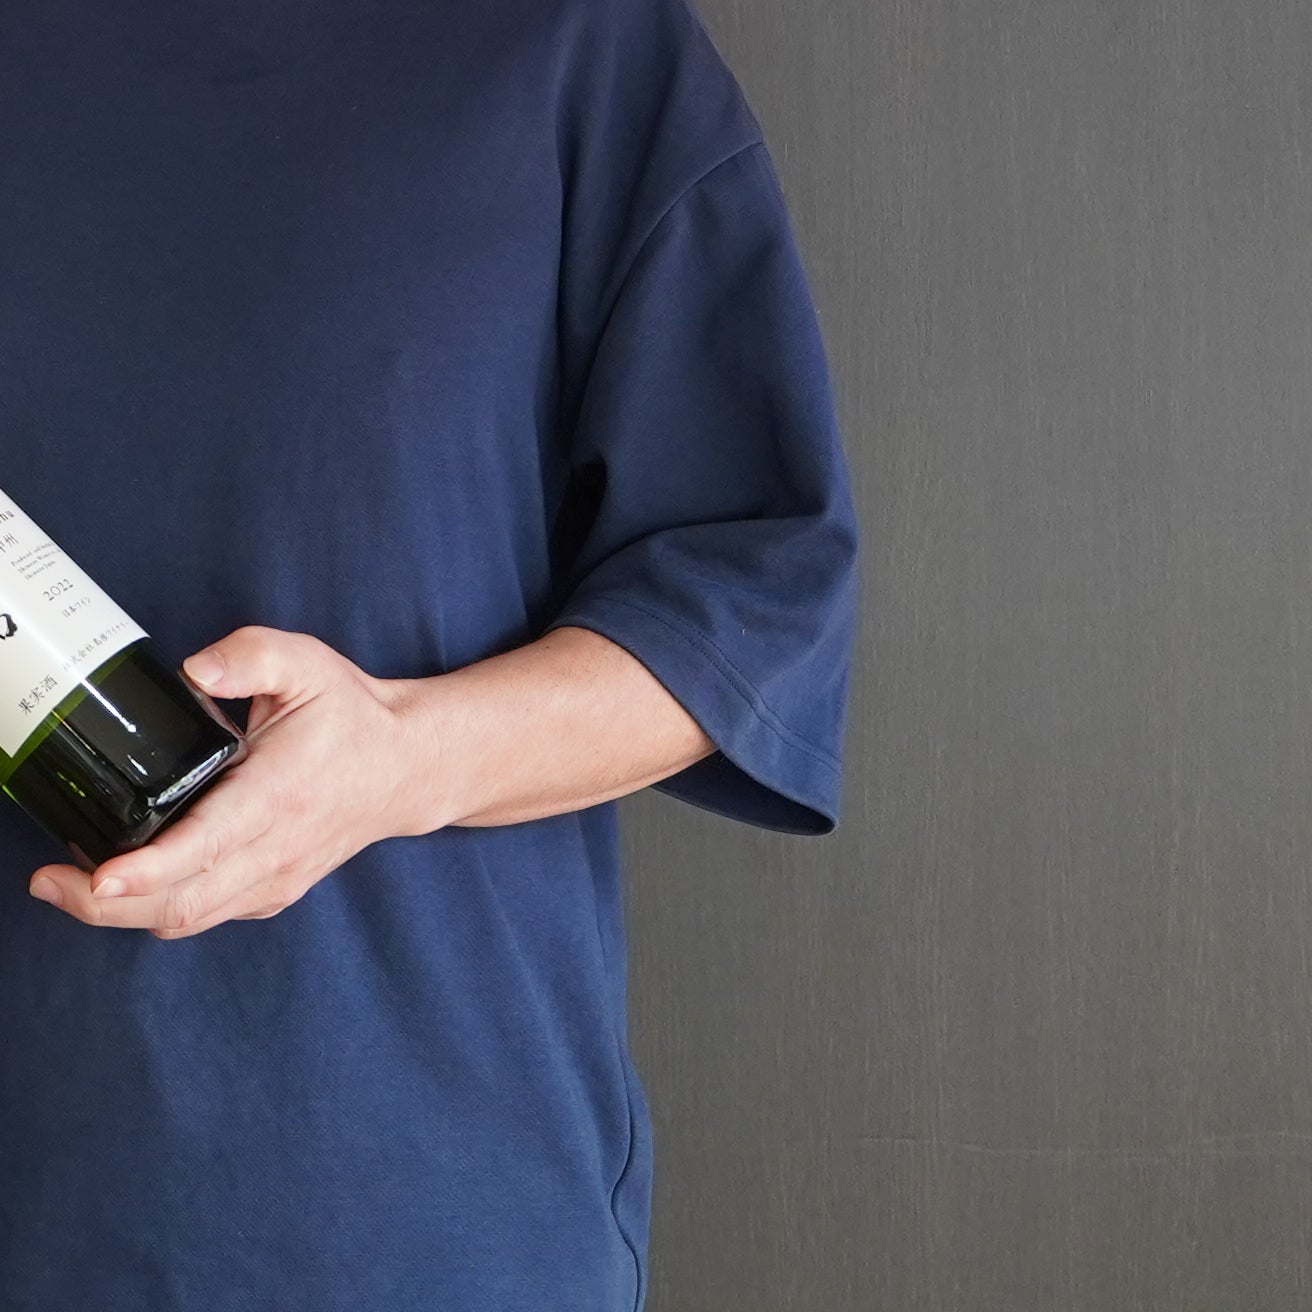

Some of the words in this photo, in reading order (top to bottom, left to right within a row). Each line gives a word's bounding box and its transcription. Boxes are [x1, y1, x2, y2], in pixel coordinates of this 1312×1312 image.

[43, 578, 74, 602] 2022
[18, 675, 58, 714] 果実酒
